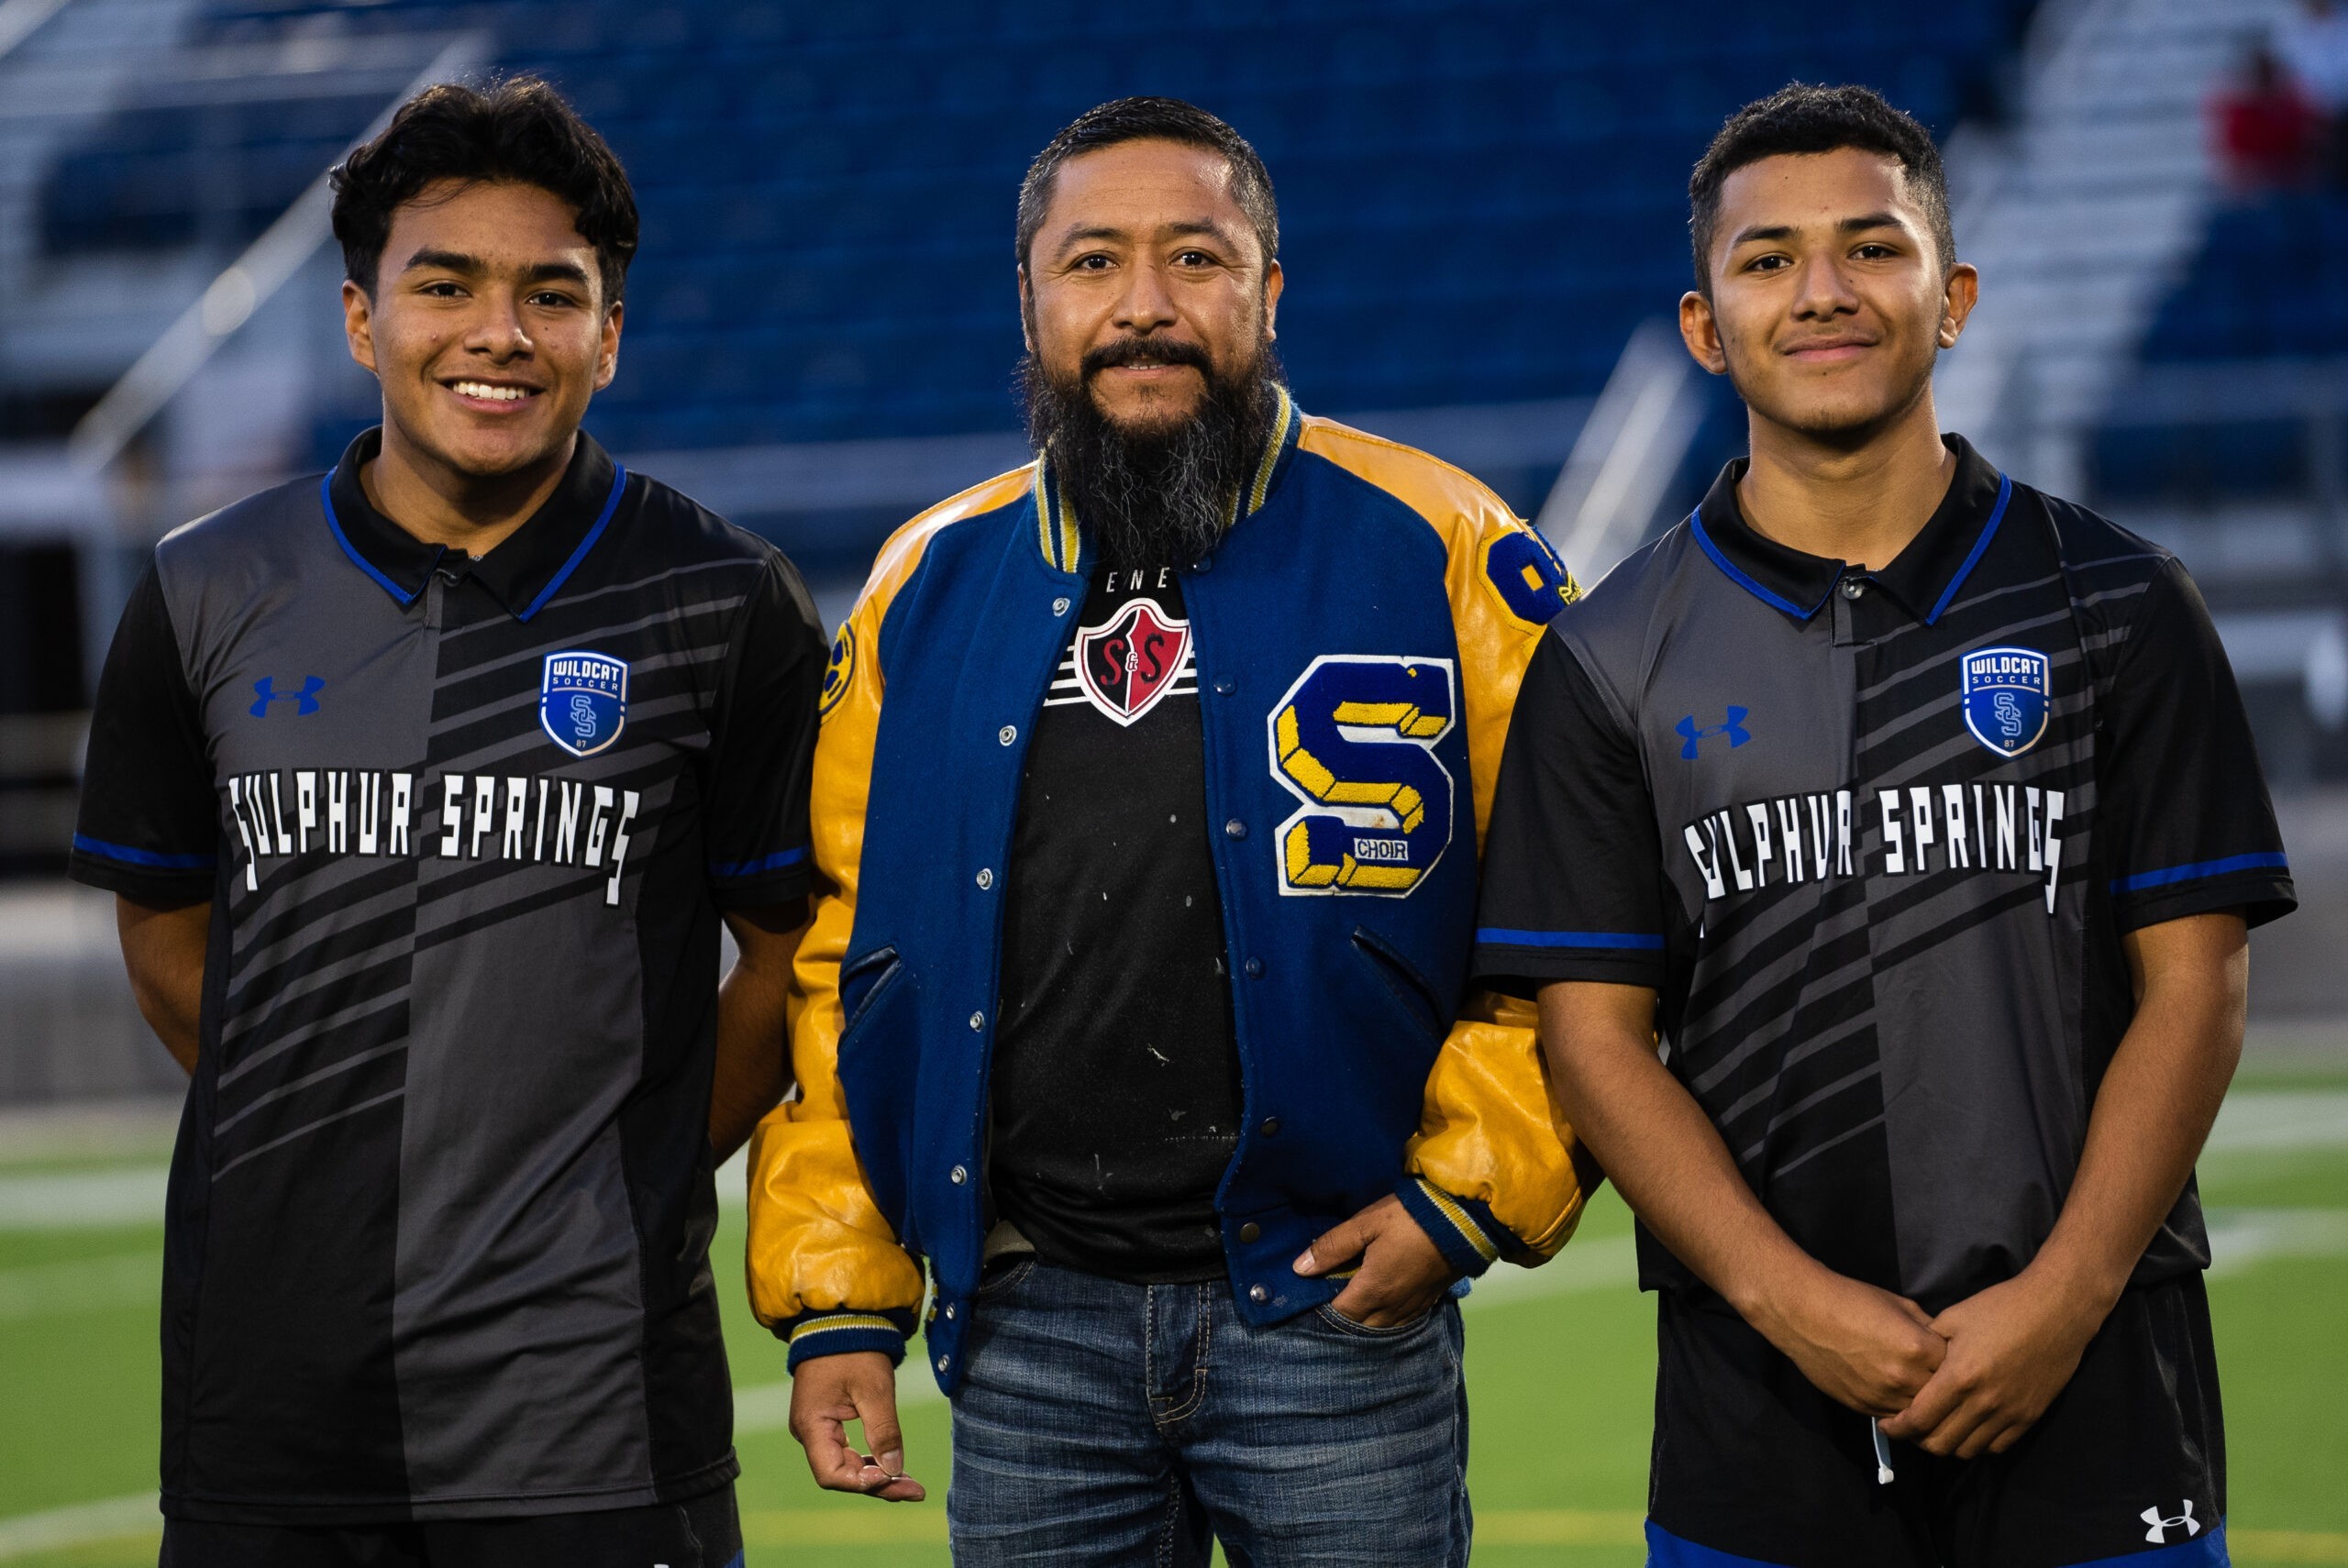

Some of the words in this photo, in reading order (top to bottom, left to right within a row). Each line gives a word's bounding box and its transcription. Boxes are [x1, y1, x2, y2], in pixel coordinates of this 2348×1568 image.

[553, 660, 620, 682] WILDCAT
[1971, 657, 2041, 675] WILDCAT
[552, 677, 619, 691] SOCCER
[1972, 675, 2041, 685] SOCCER
[576, 739, 587, 748] 87
[2003, 739, 2015, 747] 87
[1268, 655, 1456, 899] S
[228, 770, 412, 891] SULPHUR
[440, 774, 640, 906] SPRINGS
[1357, 839, 1407, 859] CHOIR
[1878, 783, 2066, 914] SPRINGS
